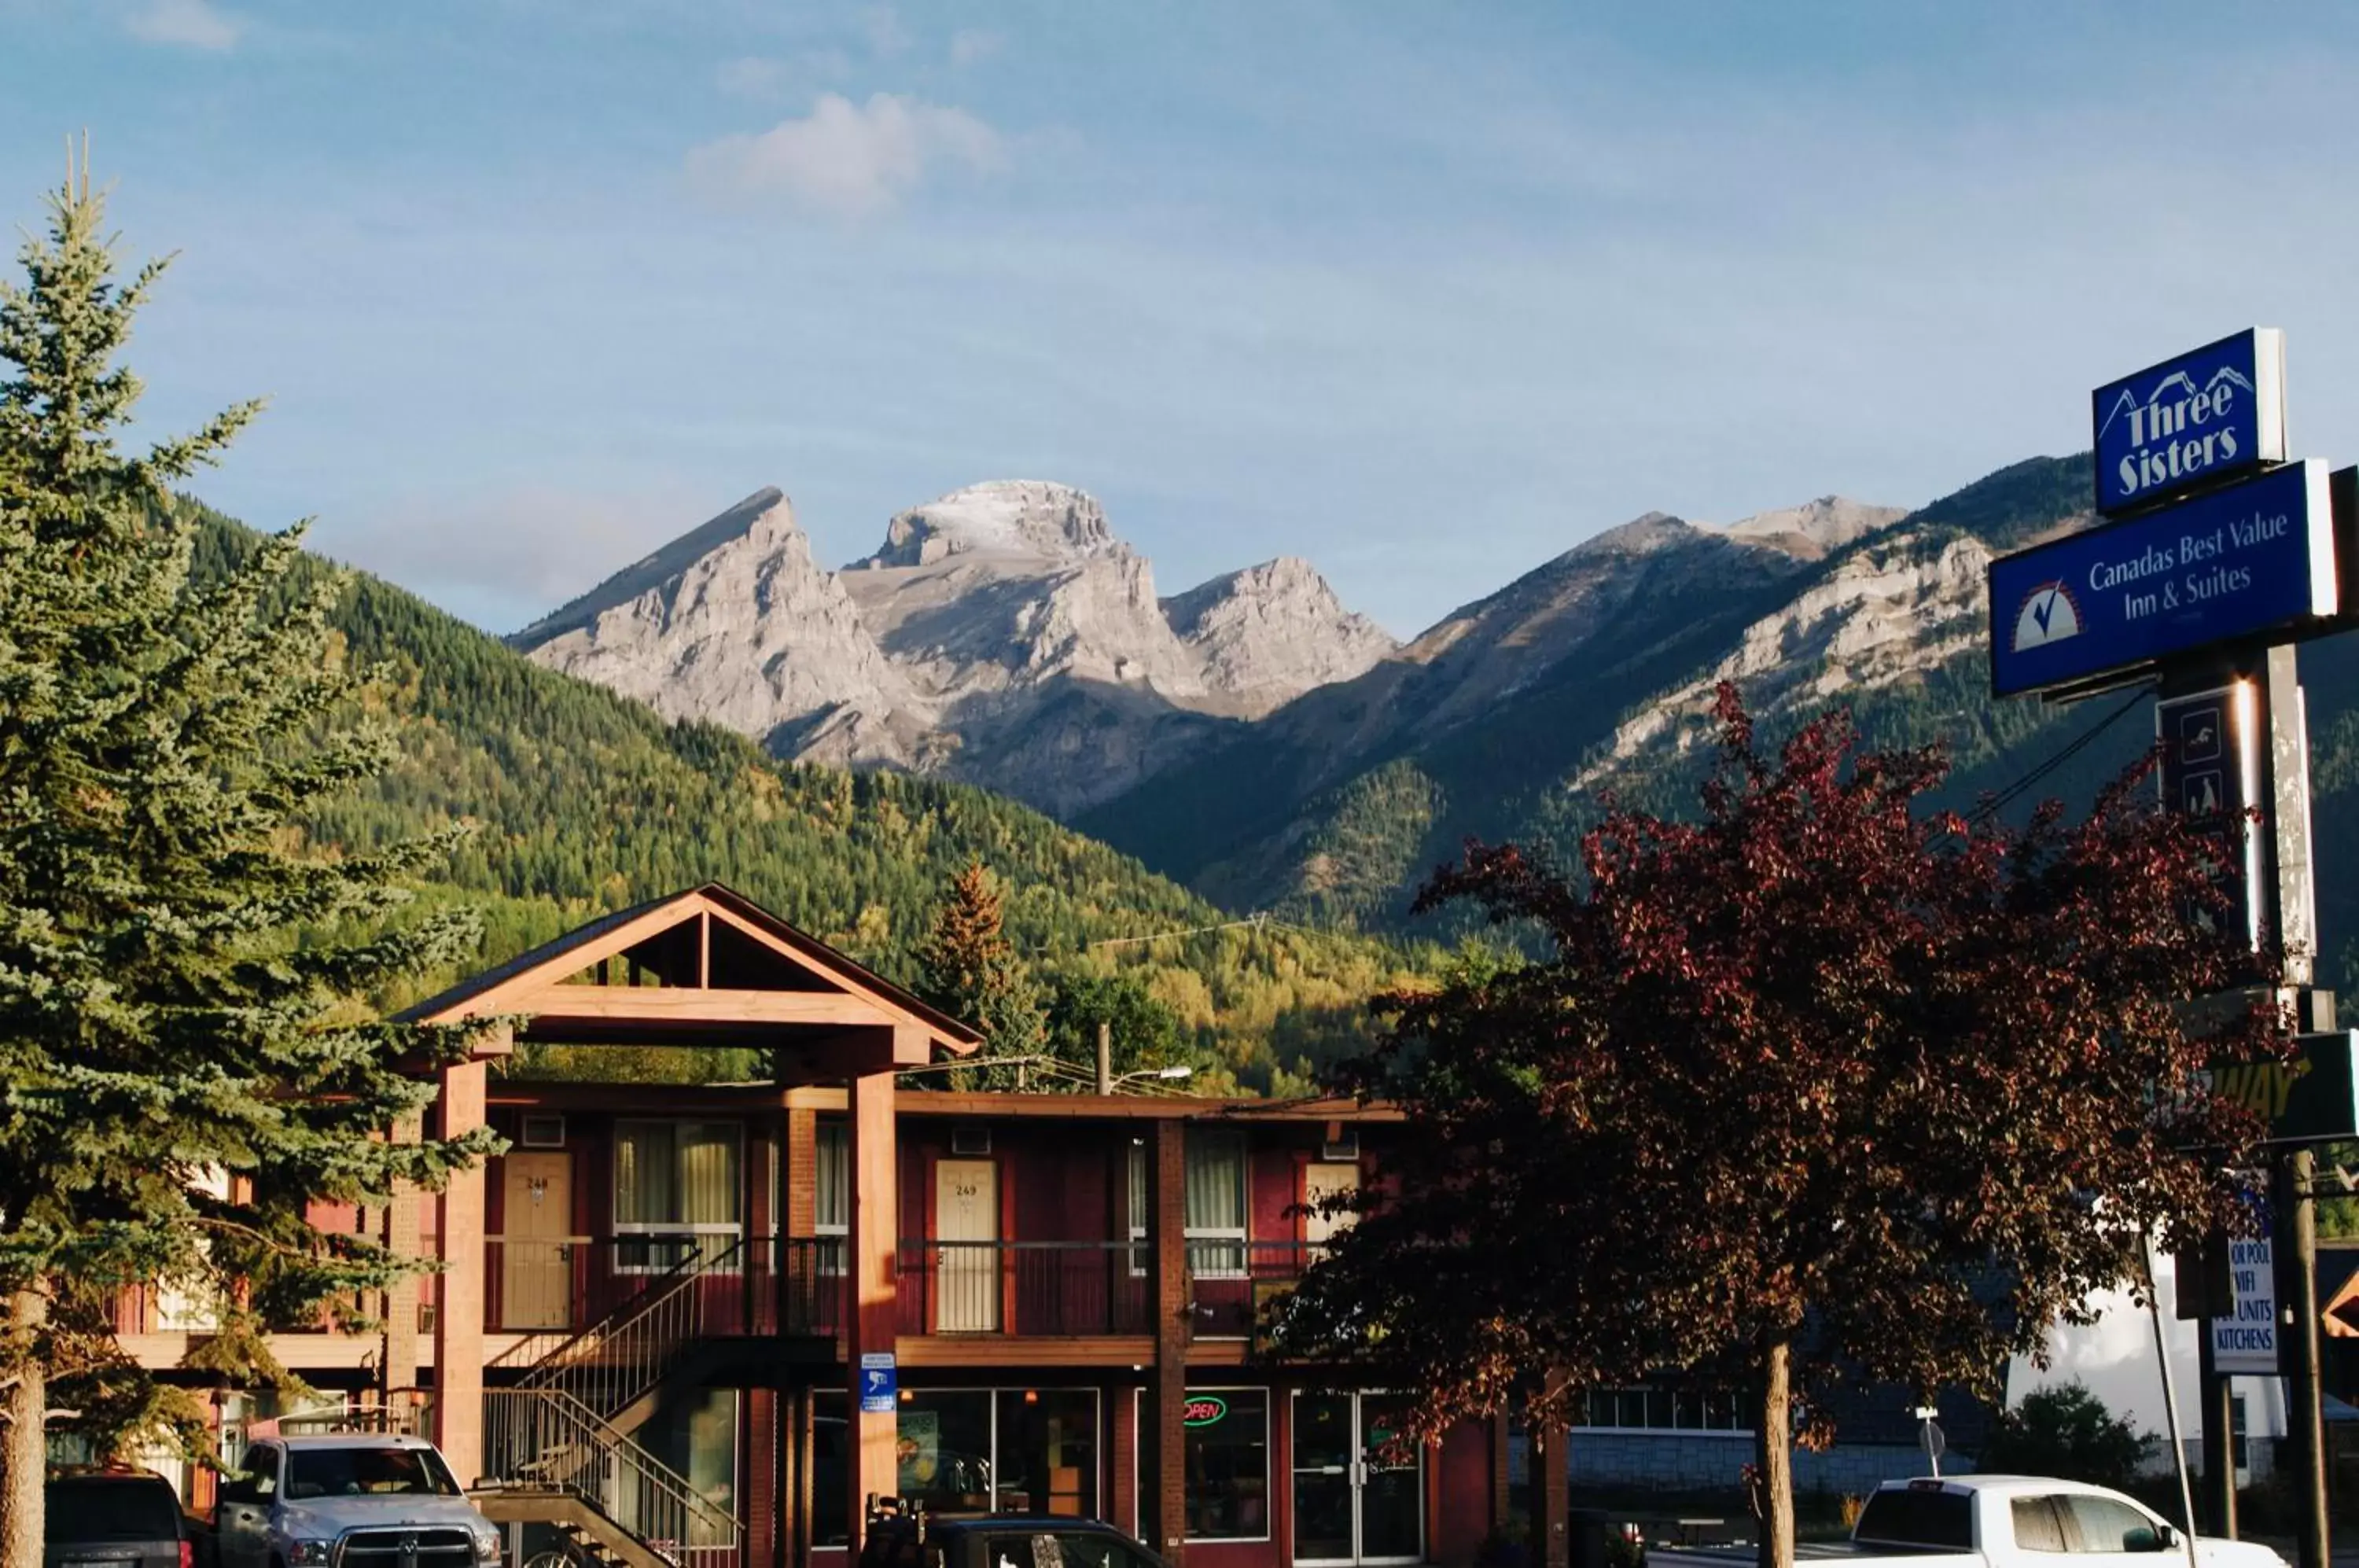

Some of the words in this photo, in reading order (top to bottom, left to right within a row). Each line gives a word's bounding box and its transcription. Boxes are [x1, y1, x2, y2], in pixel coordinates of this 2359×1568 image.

[2125, 385, 2232, 447] Three
[2119, 426, 2237, 495] Sisters
[2089, 545, 2174, 591] Canadas
[2181, 528, 2224, 565] Best
[2230, 510, 2287, 548] Value
[2125, 593, 2157, 620] Inn
[2163, 580, 2180, 609] &
[2186, 566, 2250, 603] Suites
[2247, 1243, 2270, 1264] POOL
[2237, 1299, 2272, 1322] UNITS
[2217, 1328, 2273, 1350] KITCHENS
